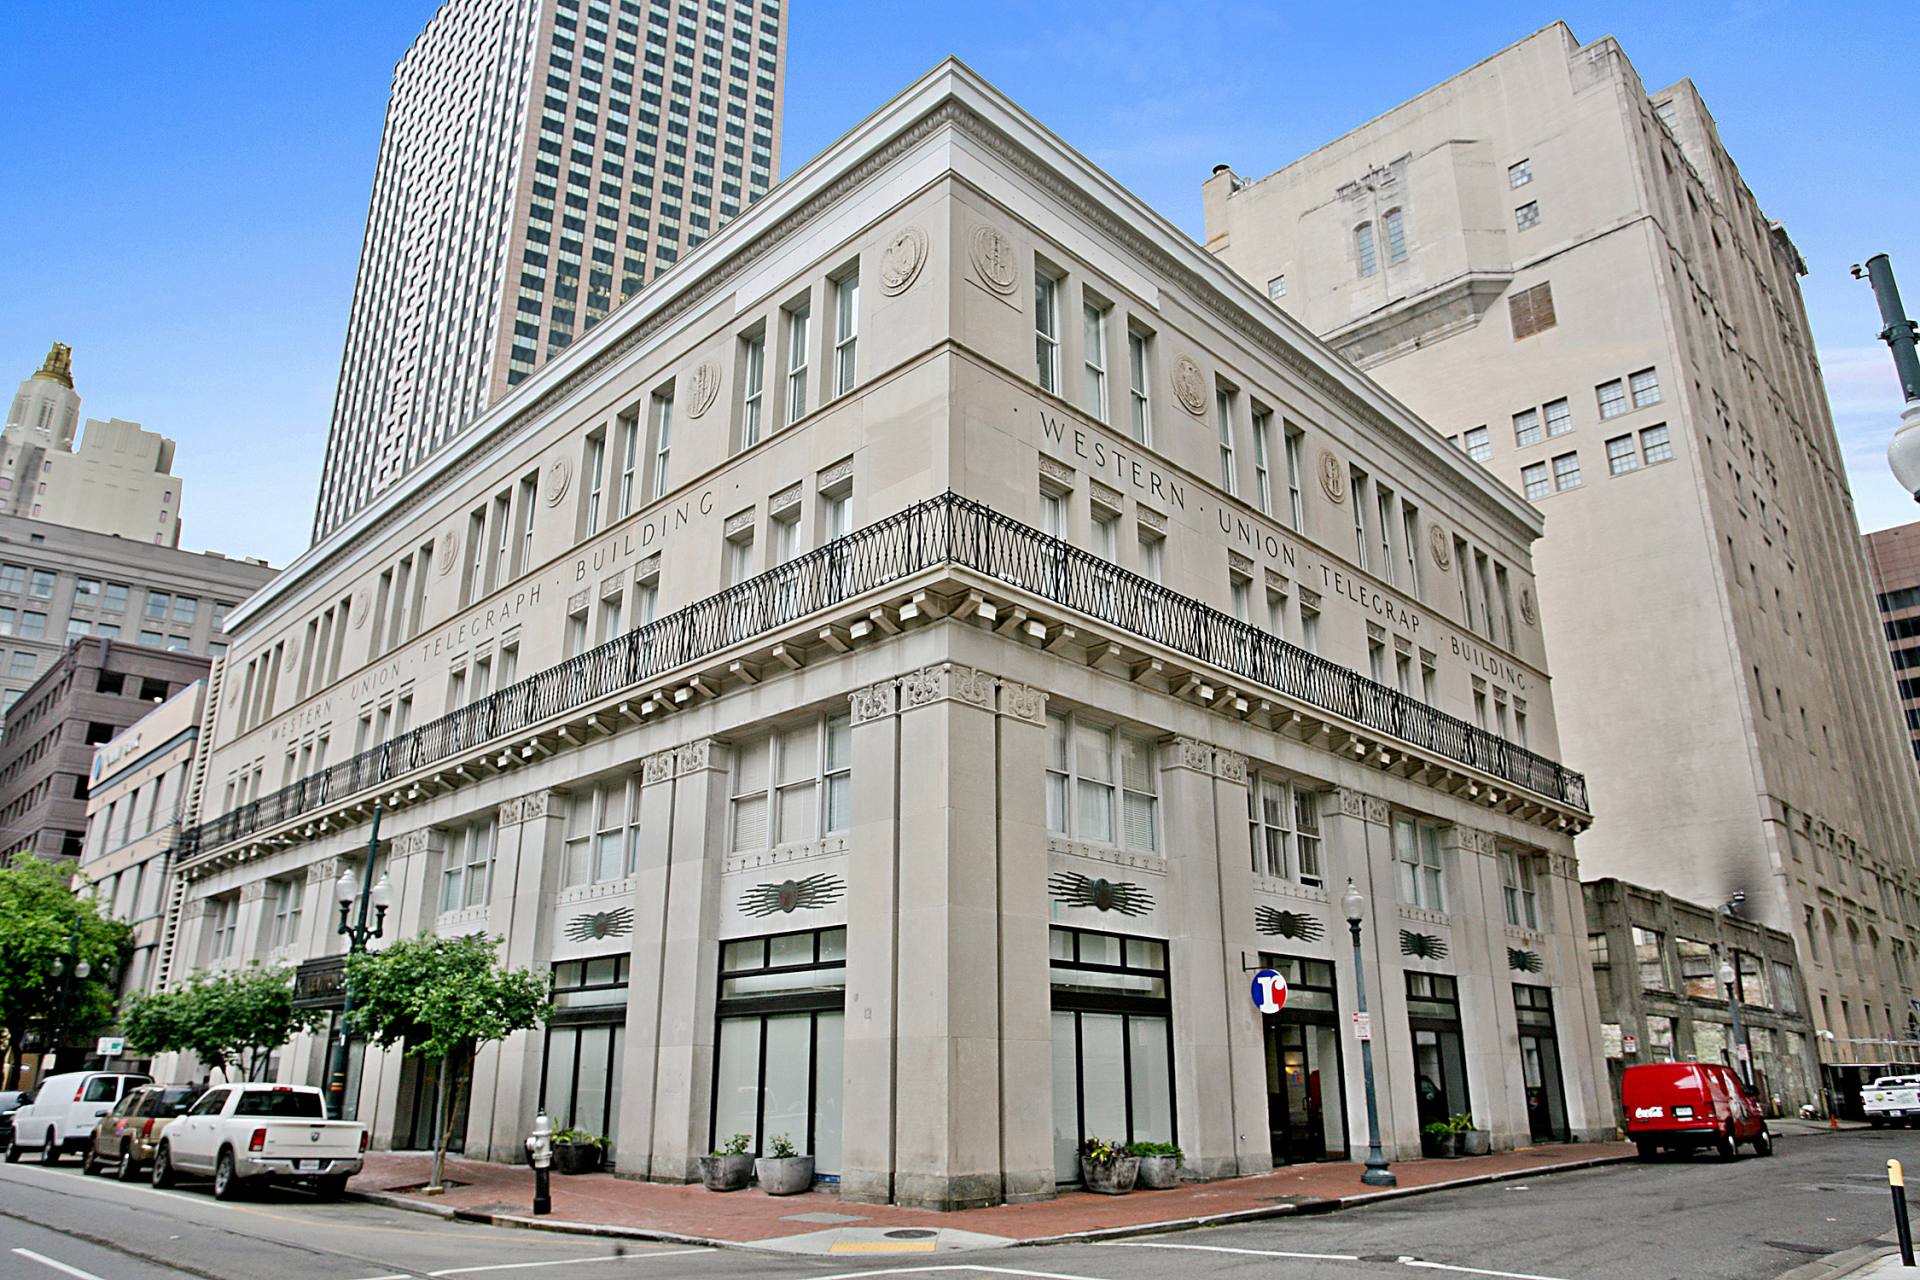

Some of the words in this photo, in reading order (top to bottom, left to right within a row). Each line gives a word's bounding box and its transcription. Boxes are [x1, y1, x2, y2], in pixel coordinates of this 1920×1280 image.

[271, 699, 332, 742] WESTERN
[351, 660, 401, 701] UNION
[422, 583, 541, 663] TELEGRAPH
[575, 491, 713, 582] BUILDING
[1040, 410, 1185, 511] WESTERN
[1218, 507, 1296, 568] UNION
[1450, 635, 1526, 691] BUILDING
